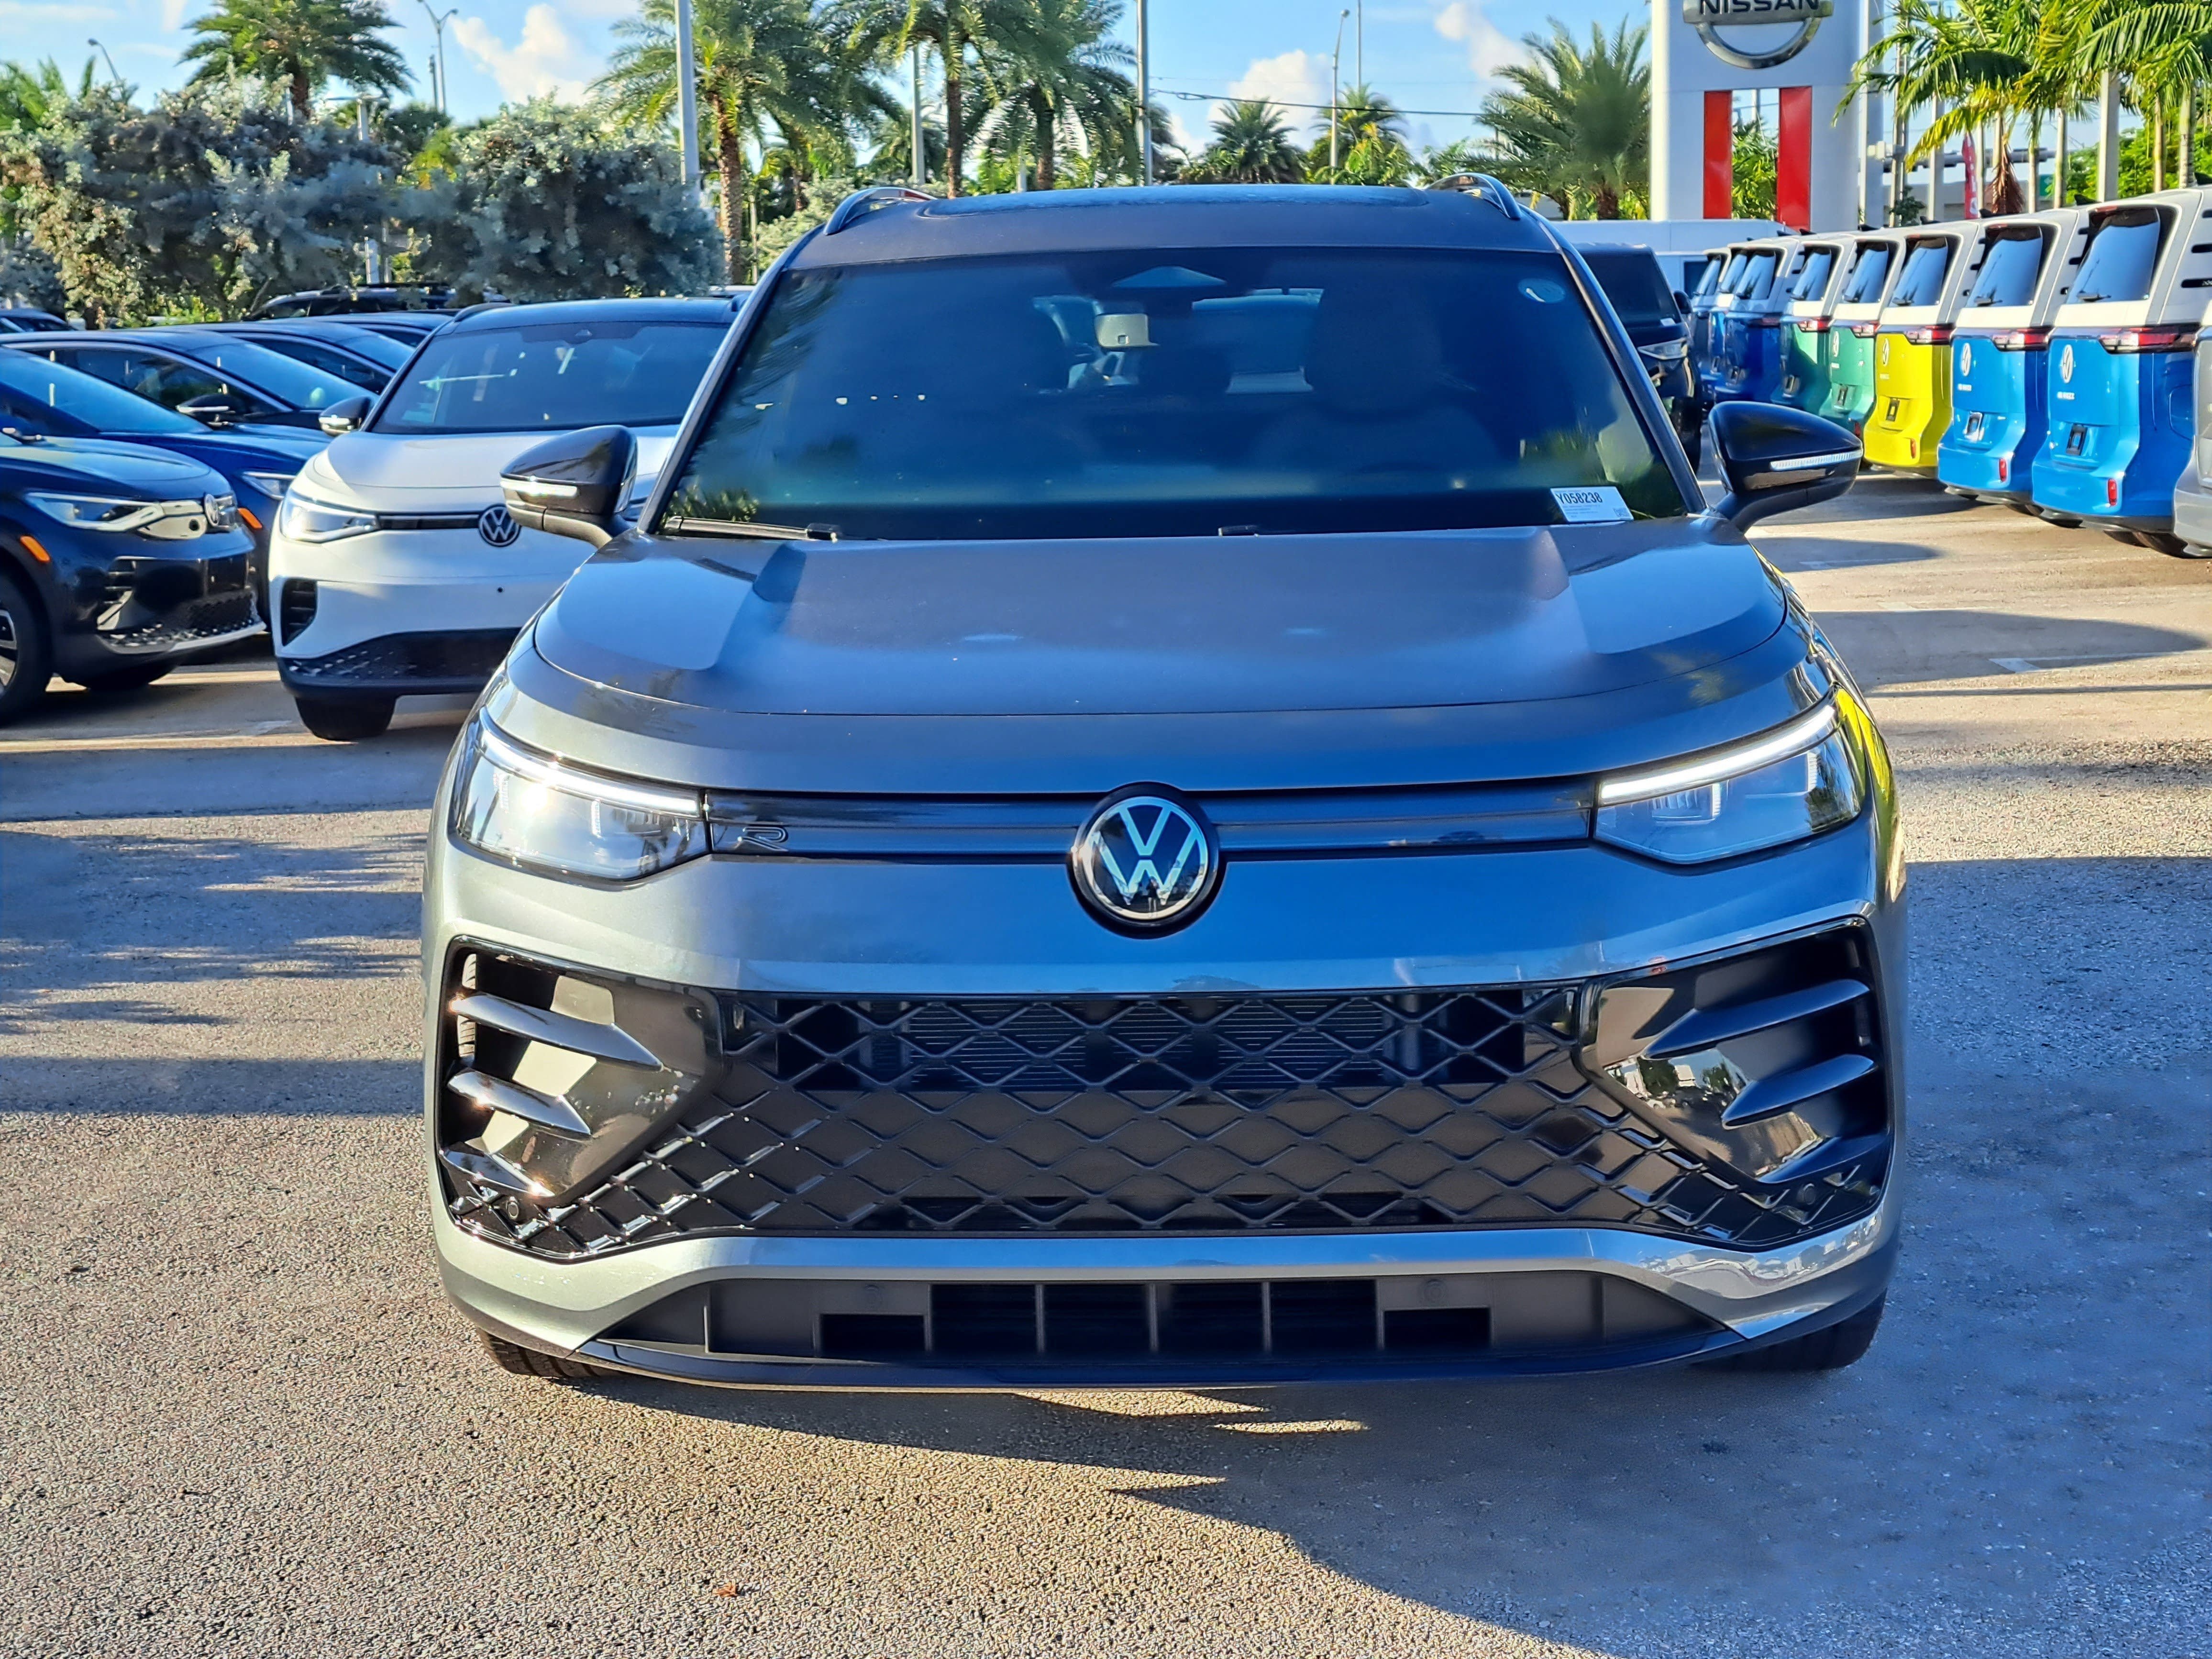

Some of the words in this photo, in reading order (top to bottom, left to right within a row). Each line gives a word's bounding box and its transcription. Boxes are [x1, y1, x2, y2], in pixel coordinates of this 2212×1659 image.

[1700, 0, 1819, 14] NISSAN
[1556, 492, 1603, 504] Y058238
[1083, 796, 1208, 920] VW
